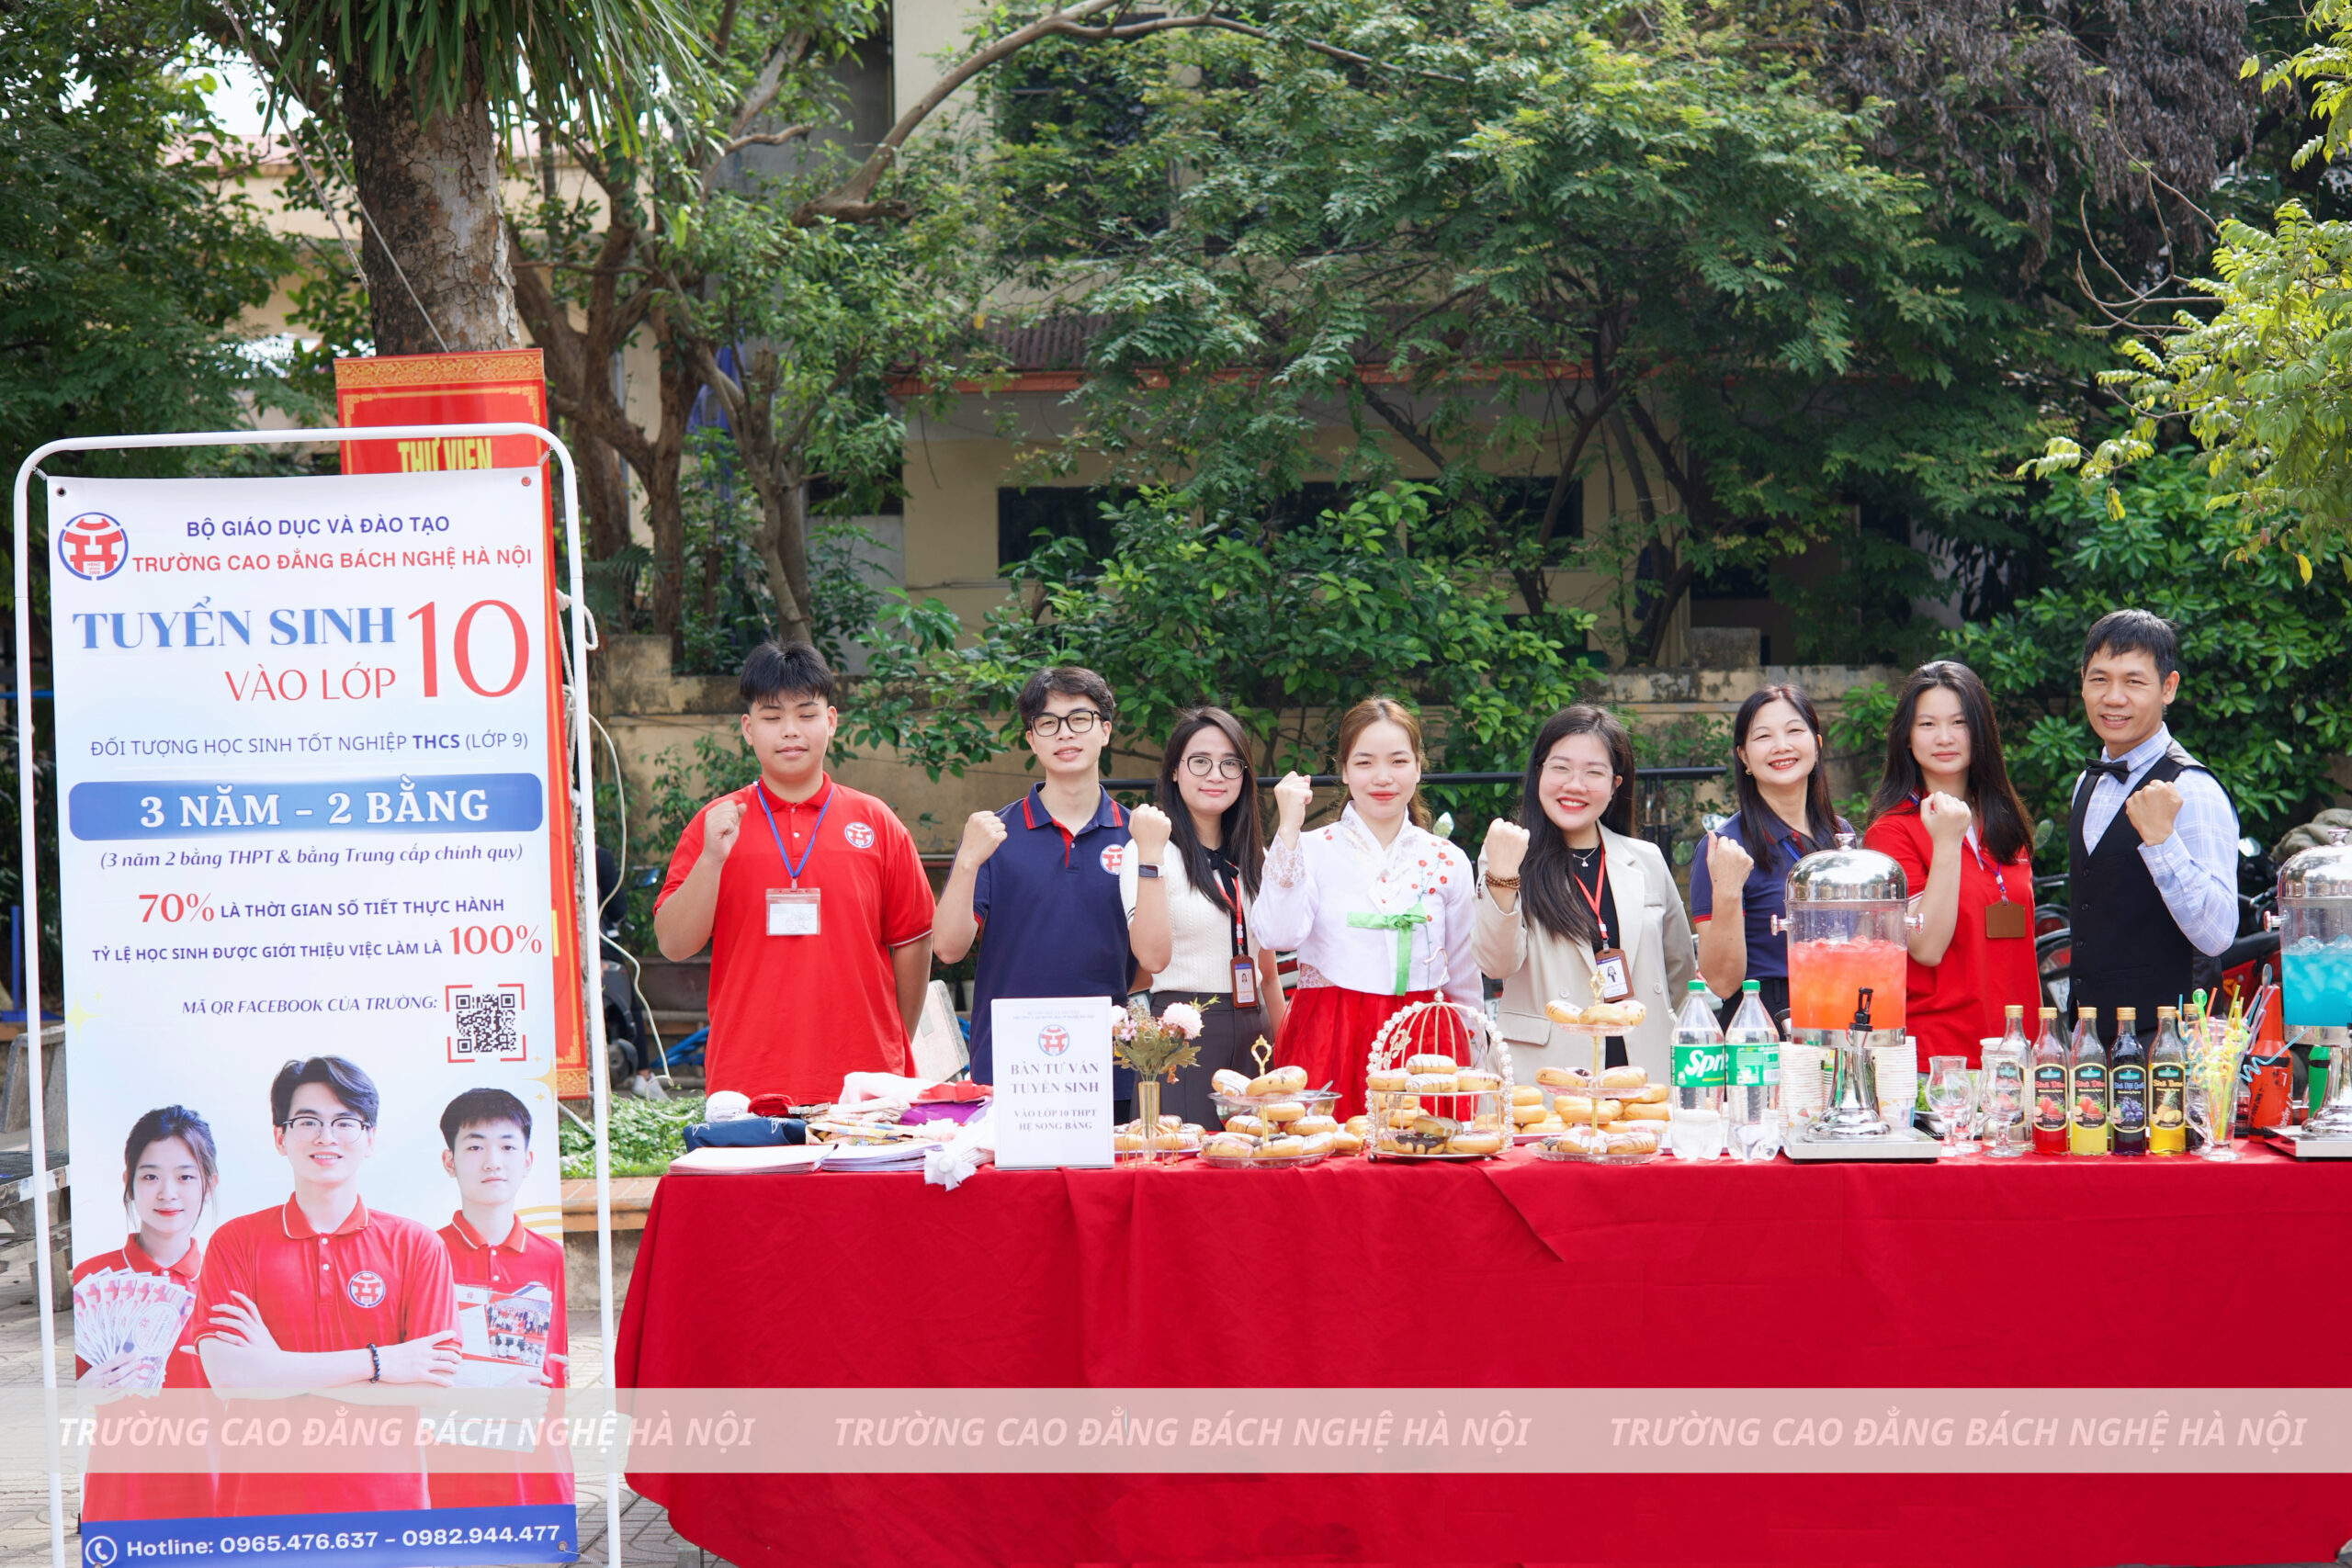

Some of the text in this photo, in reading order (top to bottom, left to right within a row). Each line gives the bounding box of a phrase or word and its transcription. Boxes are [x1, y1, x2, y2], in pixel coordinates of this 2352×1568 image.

[187, 513, 449, 540] BỘ GIÁO DỤC VÀ ĐÀO TẠO
[132, 544, 531, 572] TRƯỜNG CAO ĐẲNG BÁCH NGHỆ HÀ NỘI
[73, 595, 396, 649] TUYỂN SINH
[407, 599, 530, 699] 10
[223, 661, 396, 702] VÀO LỚP
[90, 731, 528, 757] ĐỐI TƯỢNG HỌC SINH TỐT NGHIỆP THCS (LỚP 9)
[140, 796, 165, 828] 3
[180, 784, 280, 827] NĂM
[328, 792, 353, 824] 2
[367, 773, 490, 823] BẰNG
[100, 842, 524, 871] (3 năm 2 bằng THPT & bằng Trung cấp chính quy)
[138, 893, 504, 923] 70% LÀ THỜI GIAN SỐ TIẾT THỰC HÀNH
[92, 924, 542, 964] TỶ LỆ HỌC SINH ĐƯỢC GIỚI THIỆU VIỆC LÀM LÀ 100%
[182, 993, 437, 1016] MÃ QR FACEBOOK CỦA TRƯỜNG:
[1044, 1062, 1066, 1074] TƯ
[1065, 1082, 1100, 1093] SINH
[1035, 1122, 1062, 1131] SONG
[1071, 1109, 1097, 1117] THPT
[127, 1539, 214, 1558] Hotline:
[220, 1531, 378, 1554] 0965.476.637
[402, 1526, 560, 1549] 0982.944.477
